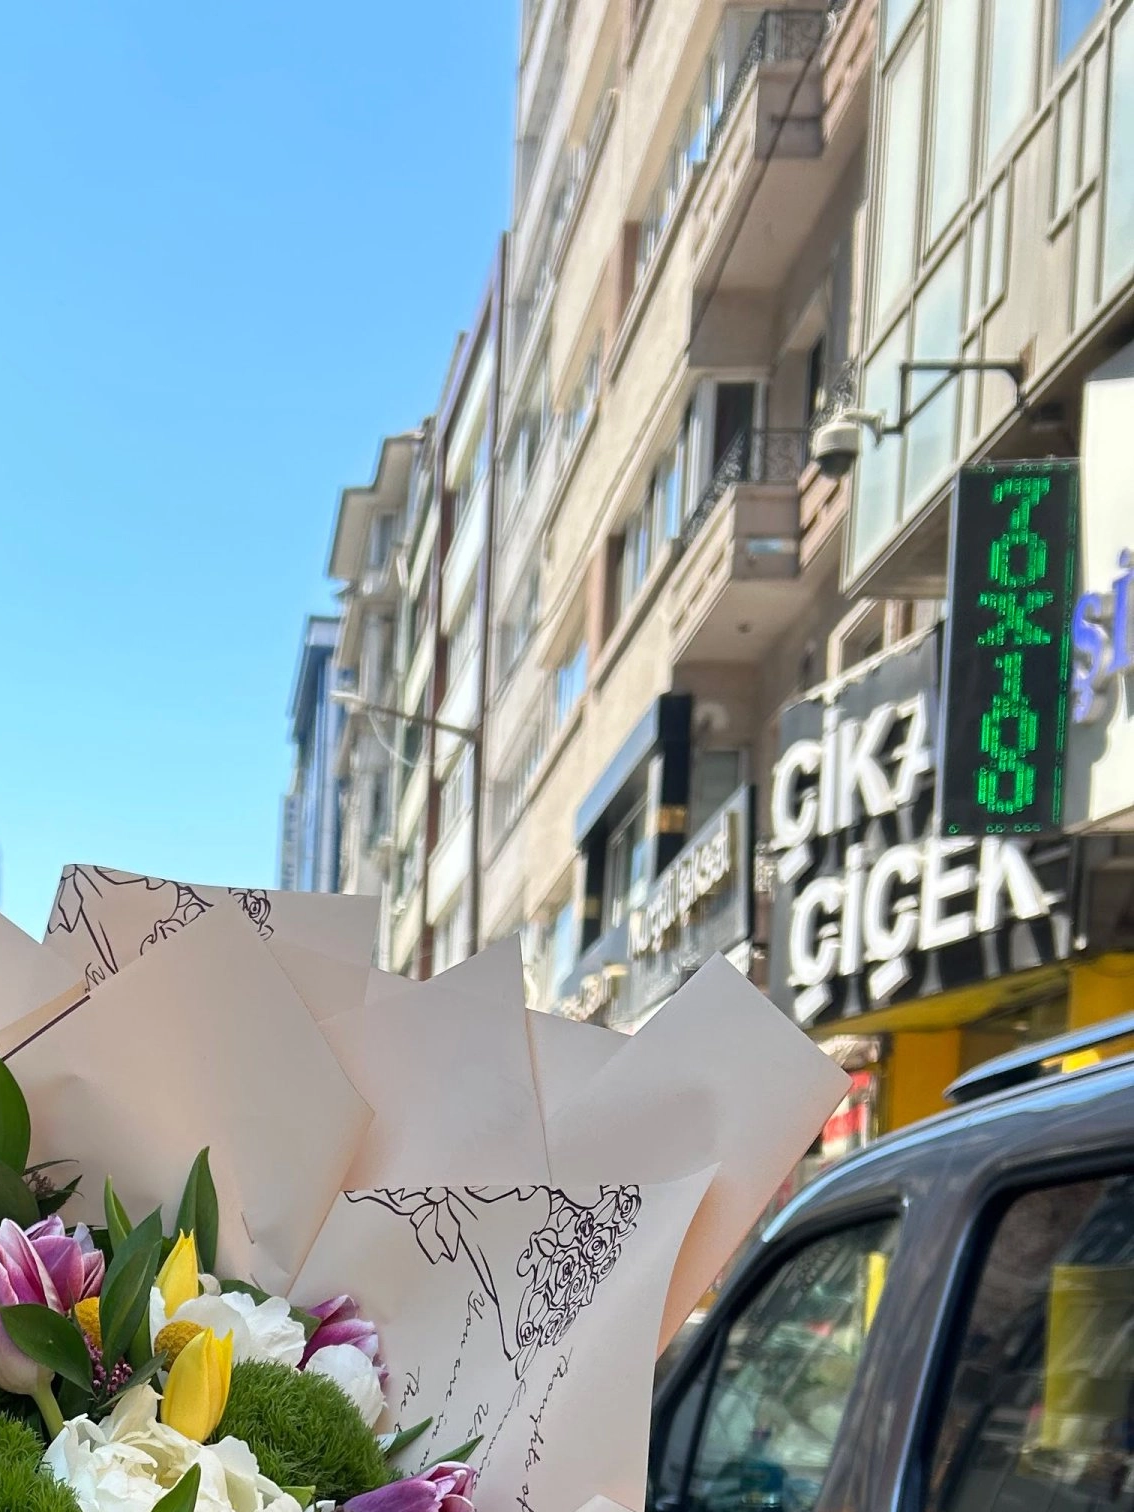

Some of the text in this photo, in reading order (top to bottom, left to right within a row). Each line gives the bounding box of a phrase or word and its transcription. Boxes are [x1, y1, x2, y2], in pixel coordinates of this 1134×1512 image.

[461, 1290, 485, 1348] You
[400, 1366, 420, 1412] The
[446, 1357, 461, 1402] are
[432, 1410, 447, 1439] in
